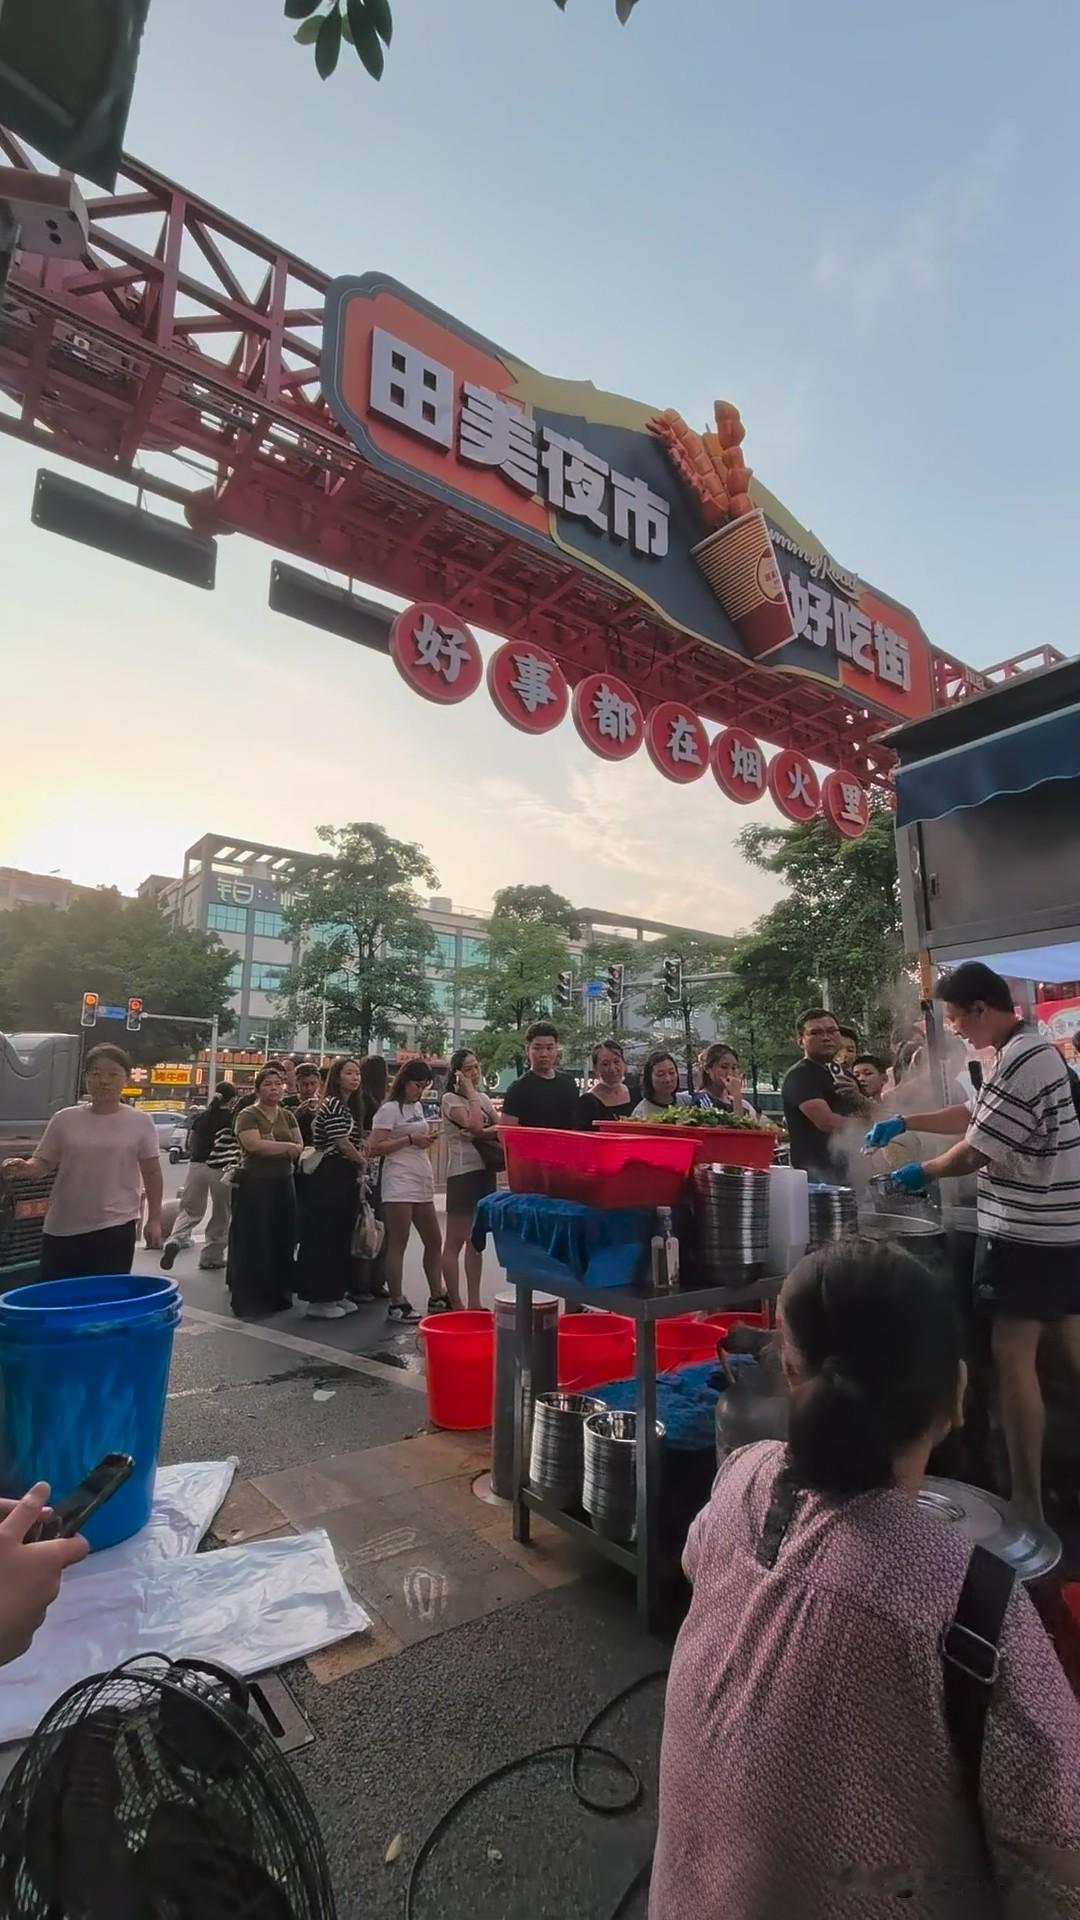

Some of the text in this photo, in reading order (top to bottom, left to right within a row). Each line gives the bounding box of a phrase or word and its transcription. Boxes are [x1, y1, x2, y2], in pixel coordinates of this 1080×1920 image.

[369, 326, 671, 557] 田美夜市
[788, 570, 911, 691] 好吃街
